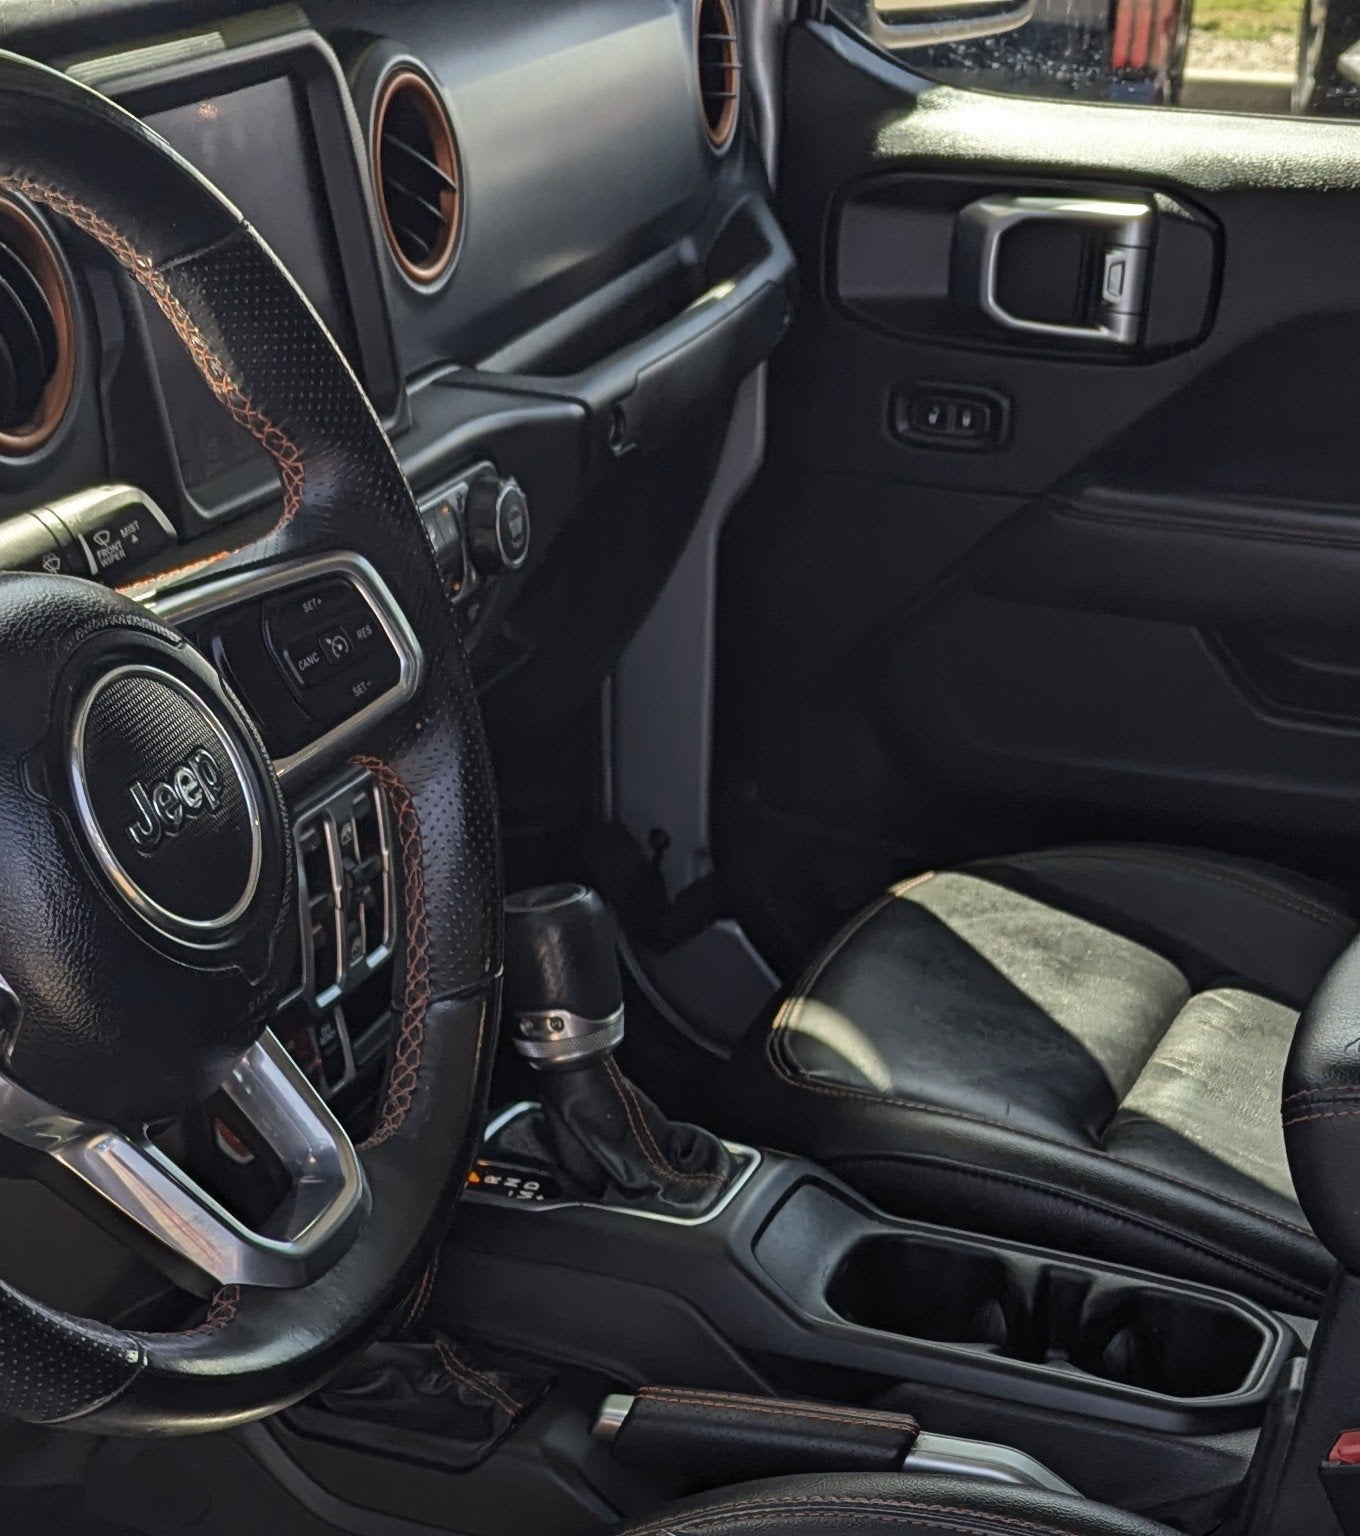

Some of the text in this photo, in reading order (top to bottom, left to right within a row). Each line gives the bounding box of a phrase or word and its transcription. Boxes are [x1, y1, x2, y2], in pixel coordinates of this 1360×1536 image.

[119, 520, 140, 538] MIST
[96, 540, 123, 559] FRONT
[298, 652, 320, 671] CANC
[127, 749, 222, 848] Jeep
